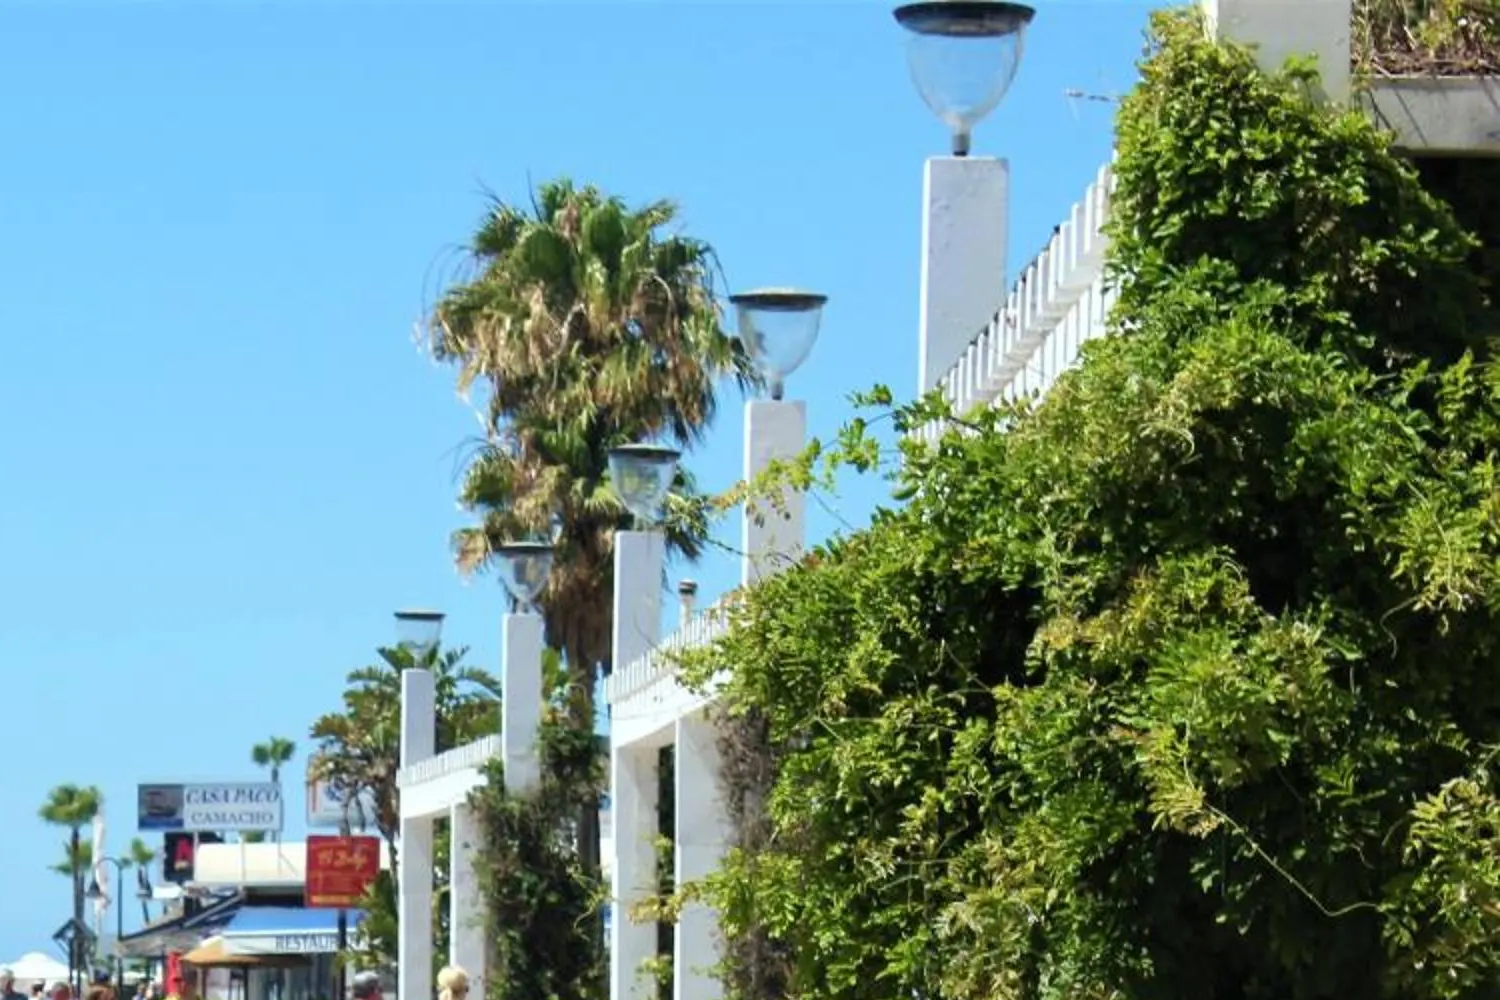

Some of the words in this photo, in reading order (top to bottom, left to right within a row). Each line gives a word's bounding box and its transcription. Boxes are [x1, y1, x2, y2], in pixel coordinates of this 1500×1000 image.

[185, 787, 230, 804] CASA
[232, 787, 280, 804] PACO
[190, 811, 274, 826] CAMACHO
